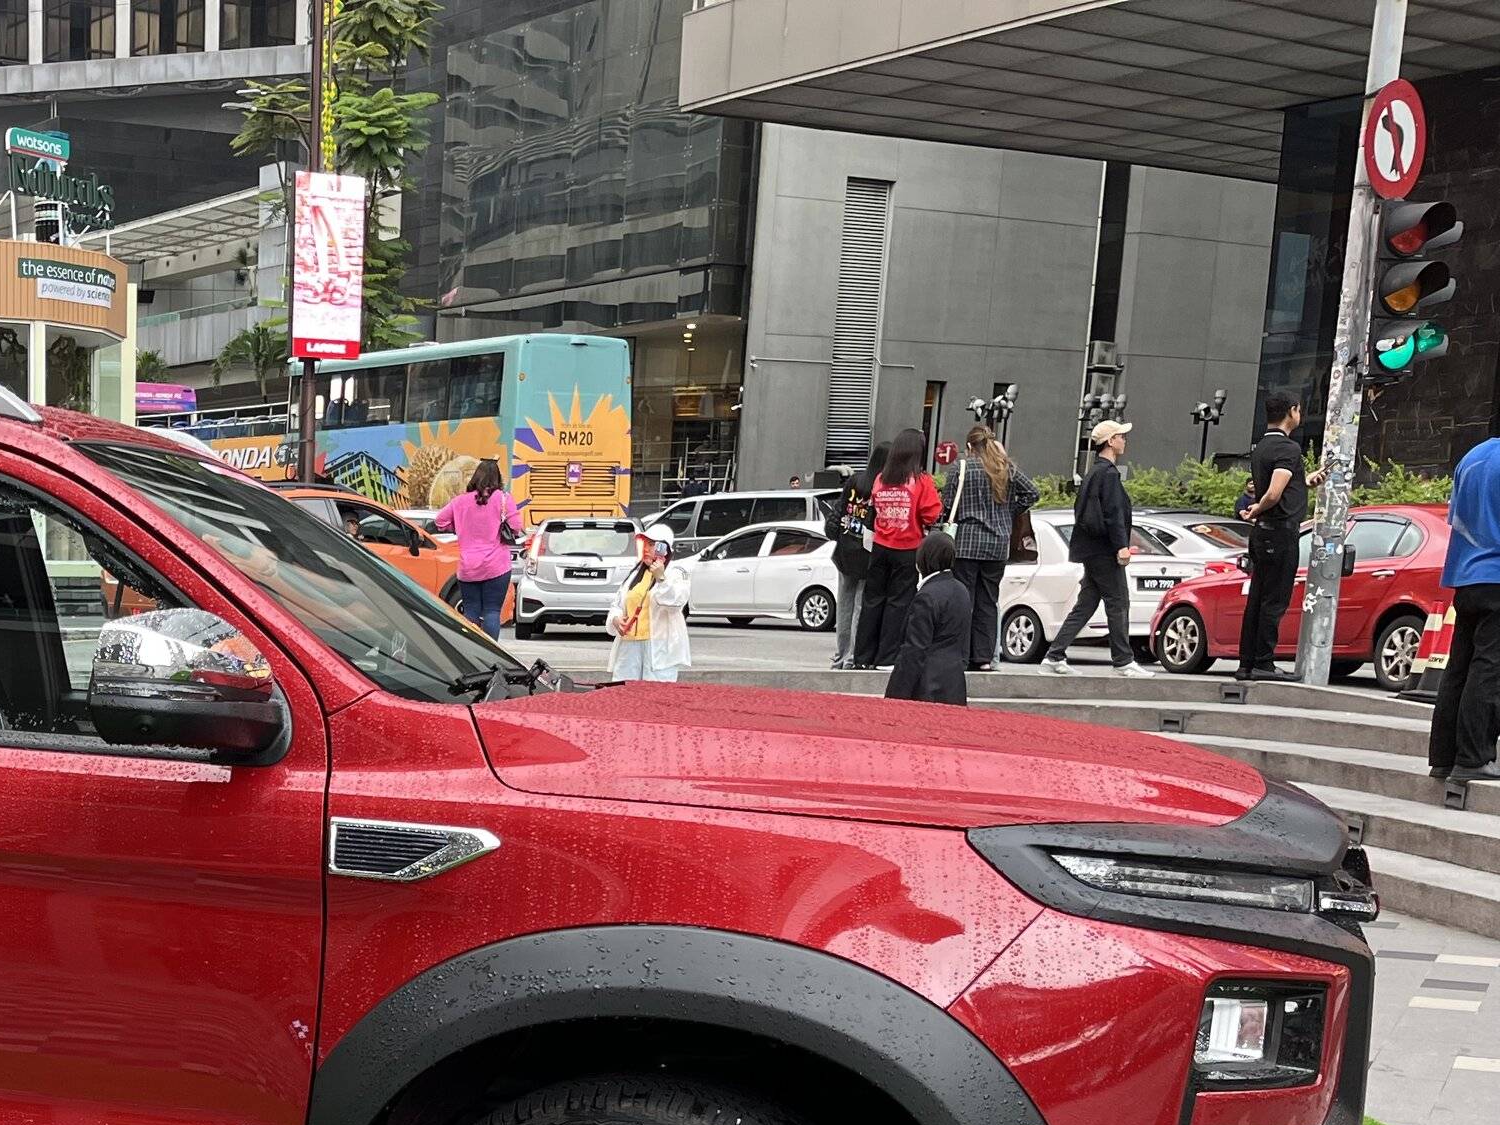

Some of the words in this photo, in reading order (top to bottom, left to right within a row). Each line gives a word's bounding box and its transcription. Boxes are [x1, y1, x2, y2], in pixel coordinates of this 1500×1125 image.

[16, 134, 63, 155] watsons
[22, 260, 44, 276] the
[46, 265, 83, 282] essence
[85, 268, 97, 283] of
[41, 282, 75, 296] powered
[76, 283, 87, 301] by
[558, 430, 594, 446] RM20
